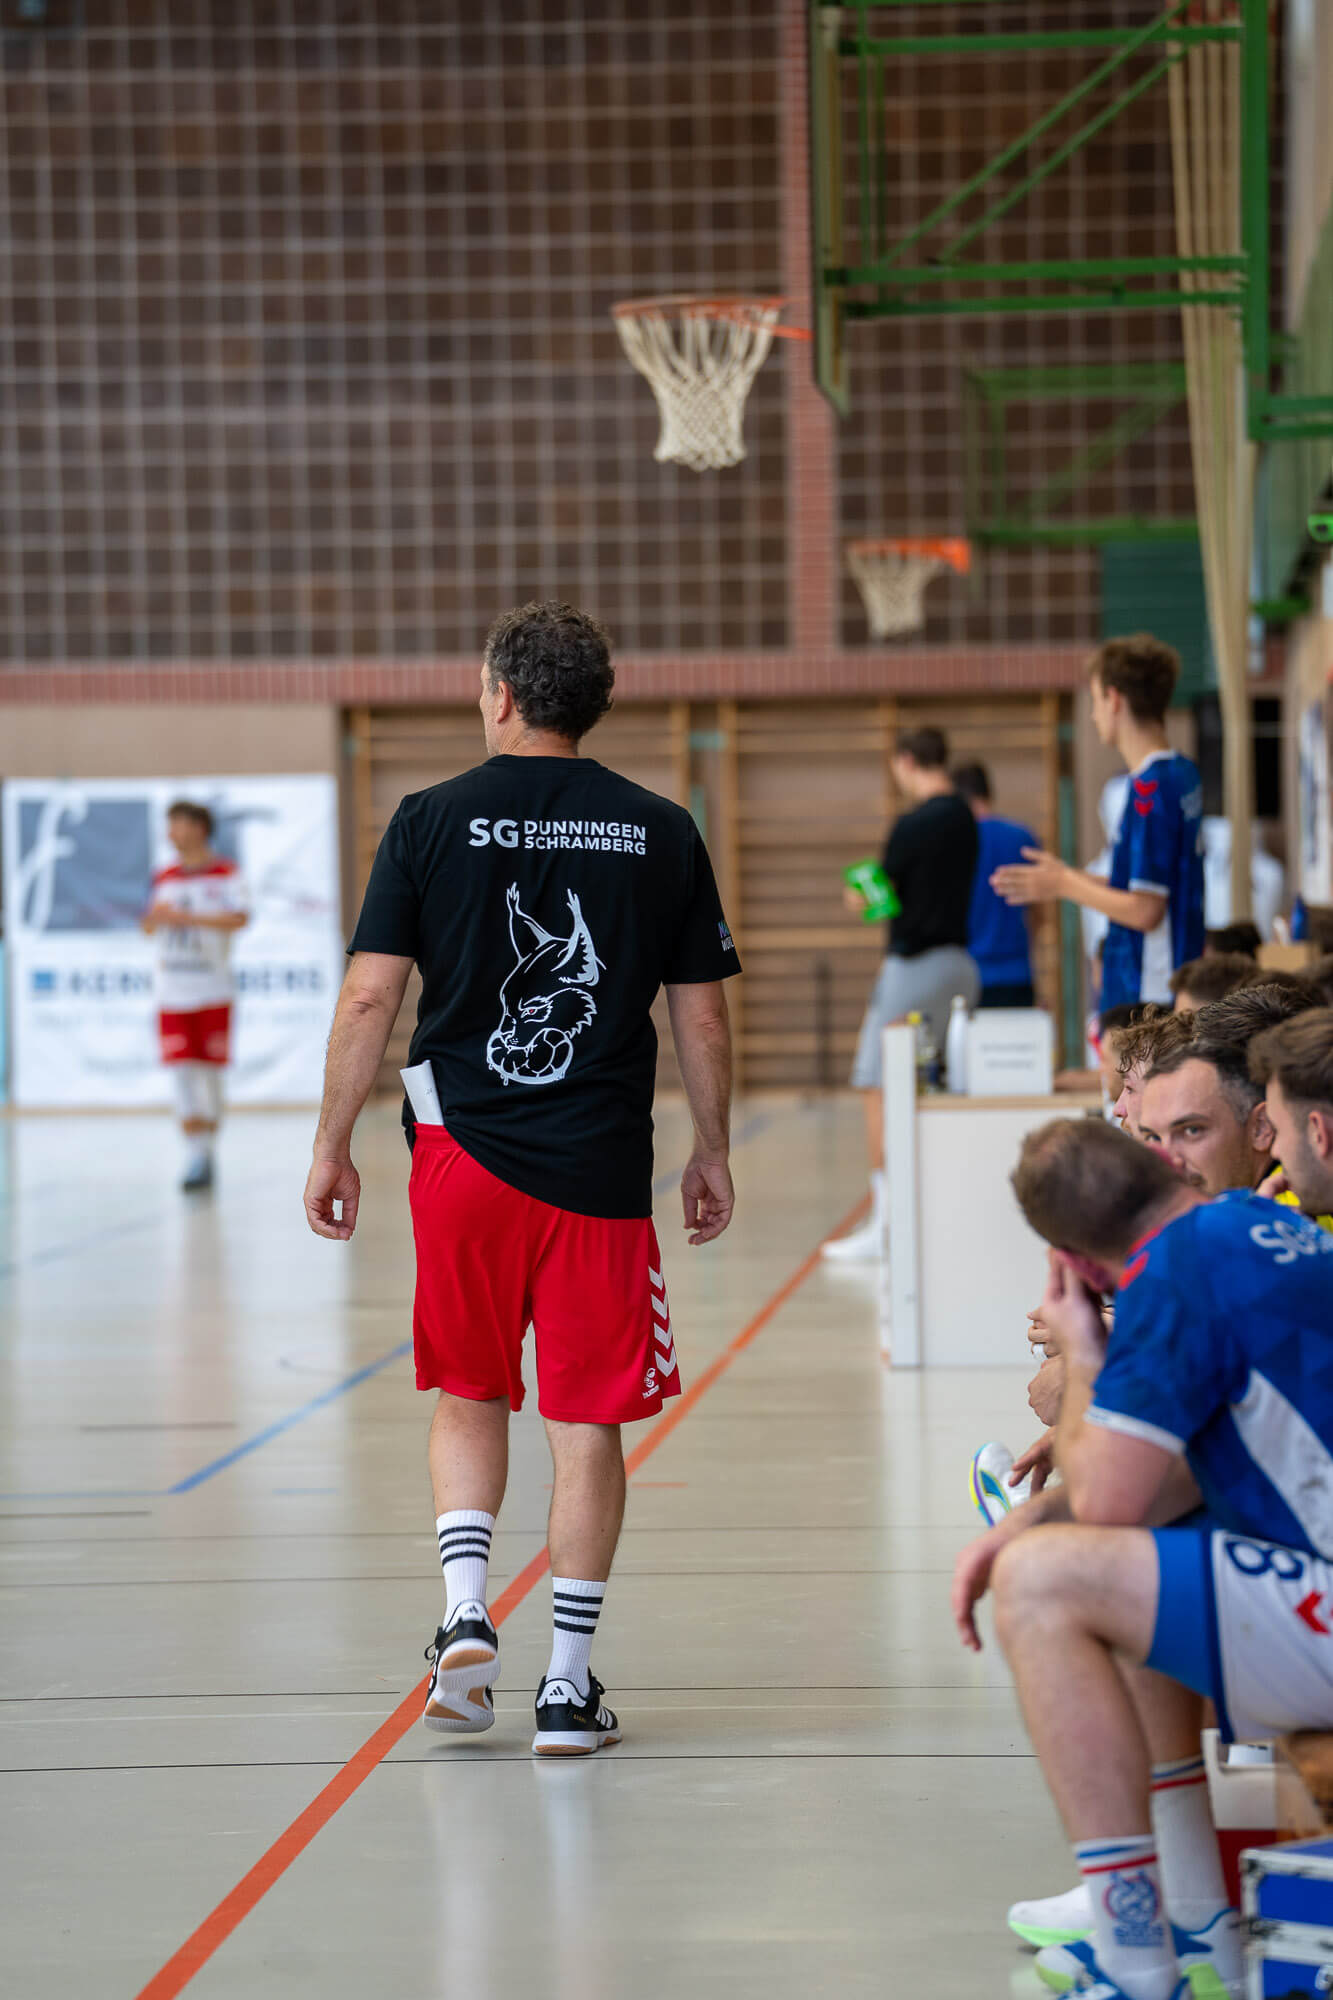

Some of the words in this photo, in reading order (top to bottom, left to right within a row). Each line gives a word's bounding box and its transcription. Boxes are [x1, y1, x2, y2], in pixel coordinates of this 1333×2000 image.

[468, 817, 519, 849] SG
[524, 820, 646, 841] DUNNINGEN
[524, 835, 646, 856] SCHRAMBERG
